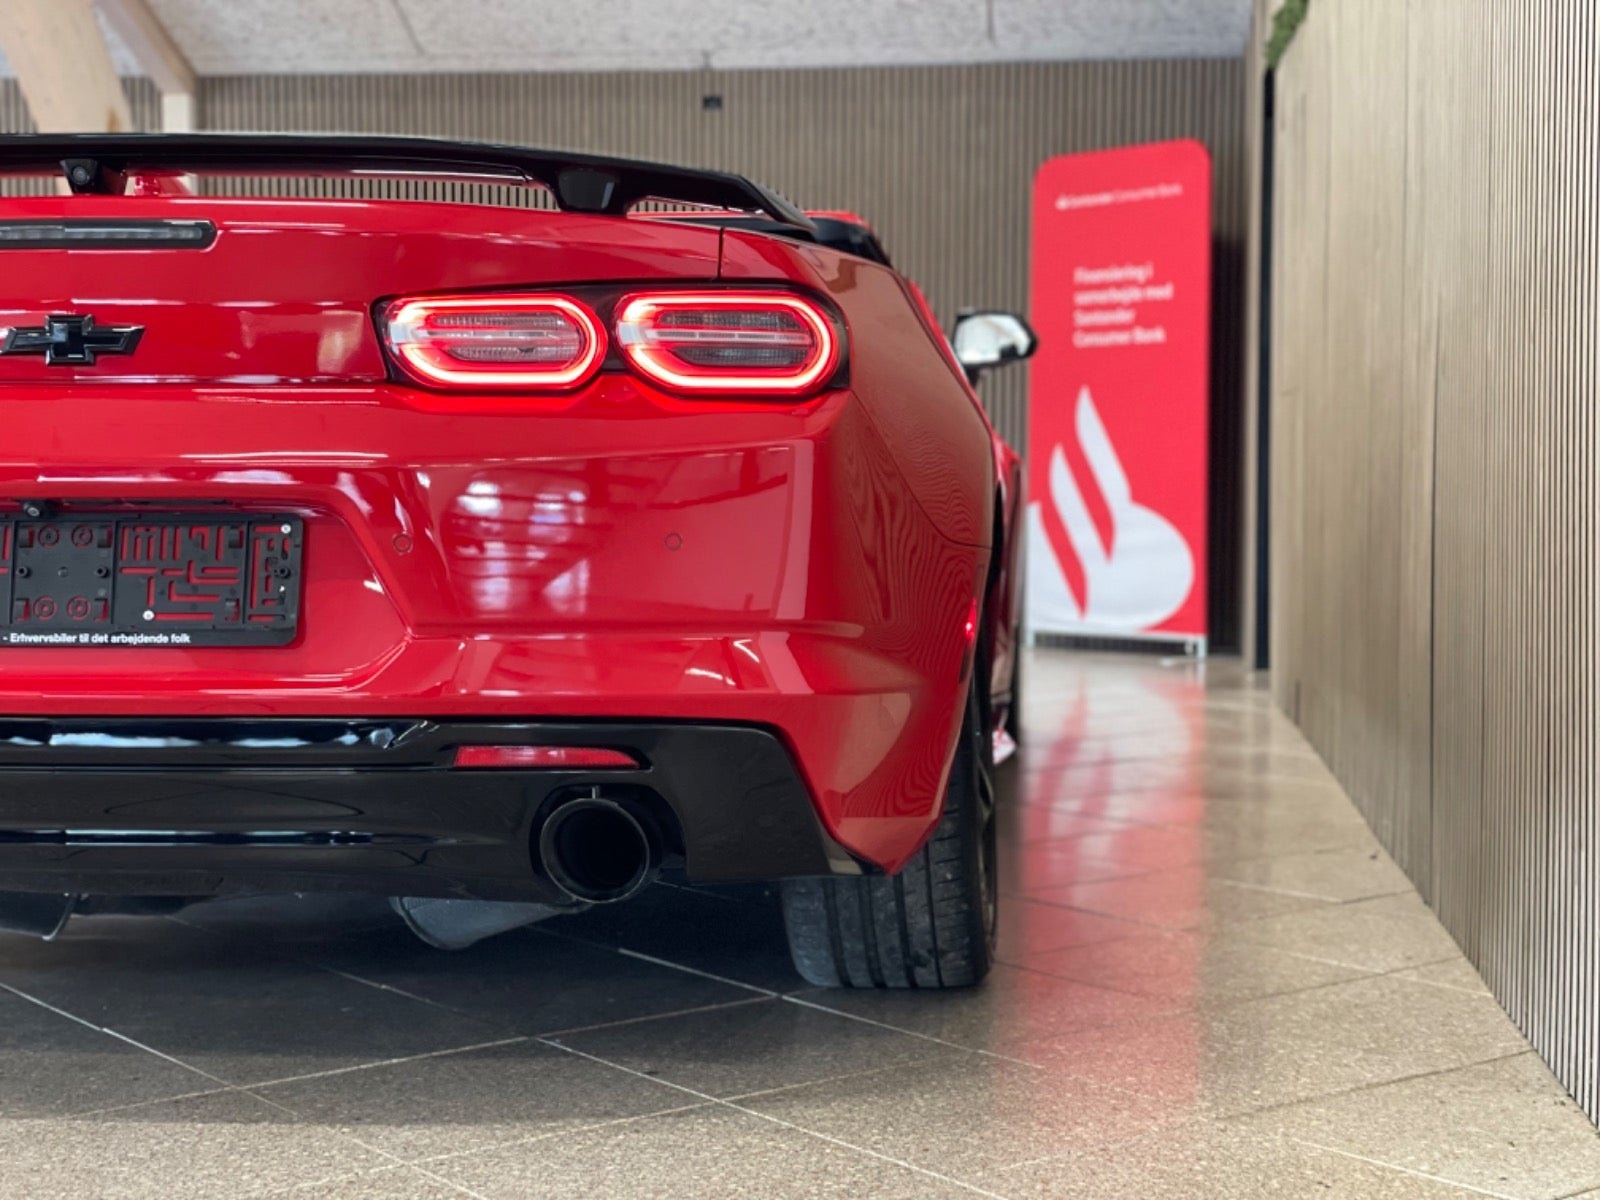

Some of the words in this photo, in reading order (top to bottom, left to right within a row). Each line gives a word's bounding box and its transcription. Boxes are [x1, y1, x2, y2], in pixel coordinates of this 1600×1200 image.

[1074, 264, 1145, 285] Finansiering
[1074, 287, 1141, 306] samarbejde
[1143, 282, 1174, 301] med
[1074, 308, 1135, 327] Santander
[1074, 329, 1131, 348] Consumer
[1133, 326, 1166, 344] Bank
[10, 633, 77, 643] Erhvervsbiler
[79, 633, 89, 643] til
[91, 633, 108, 643] det
[111, 633, 168, 645] arbejdende
[171, 633, 191, 643] folk
